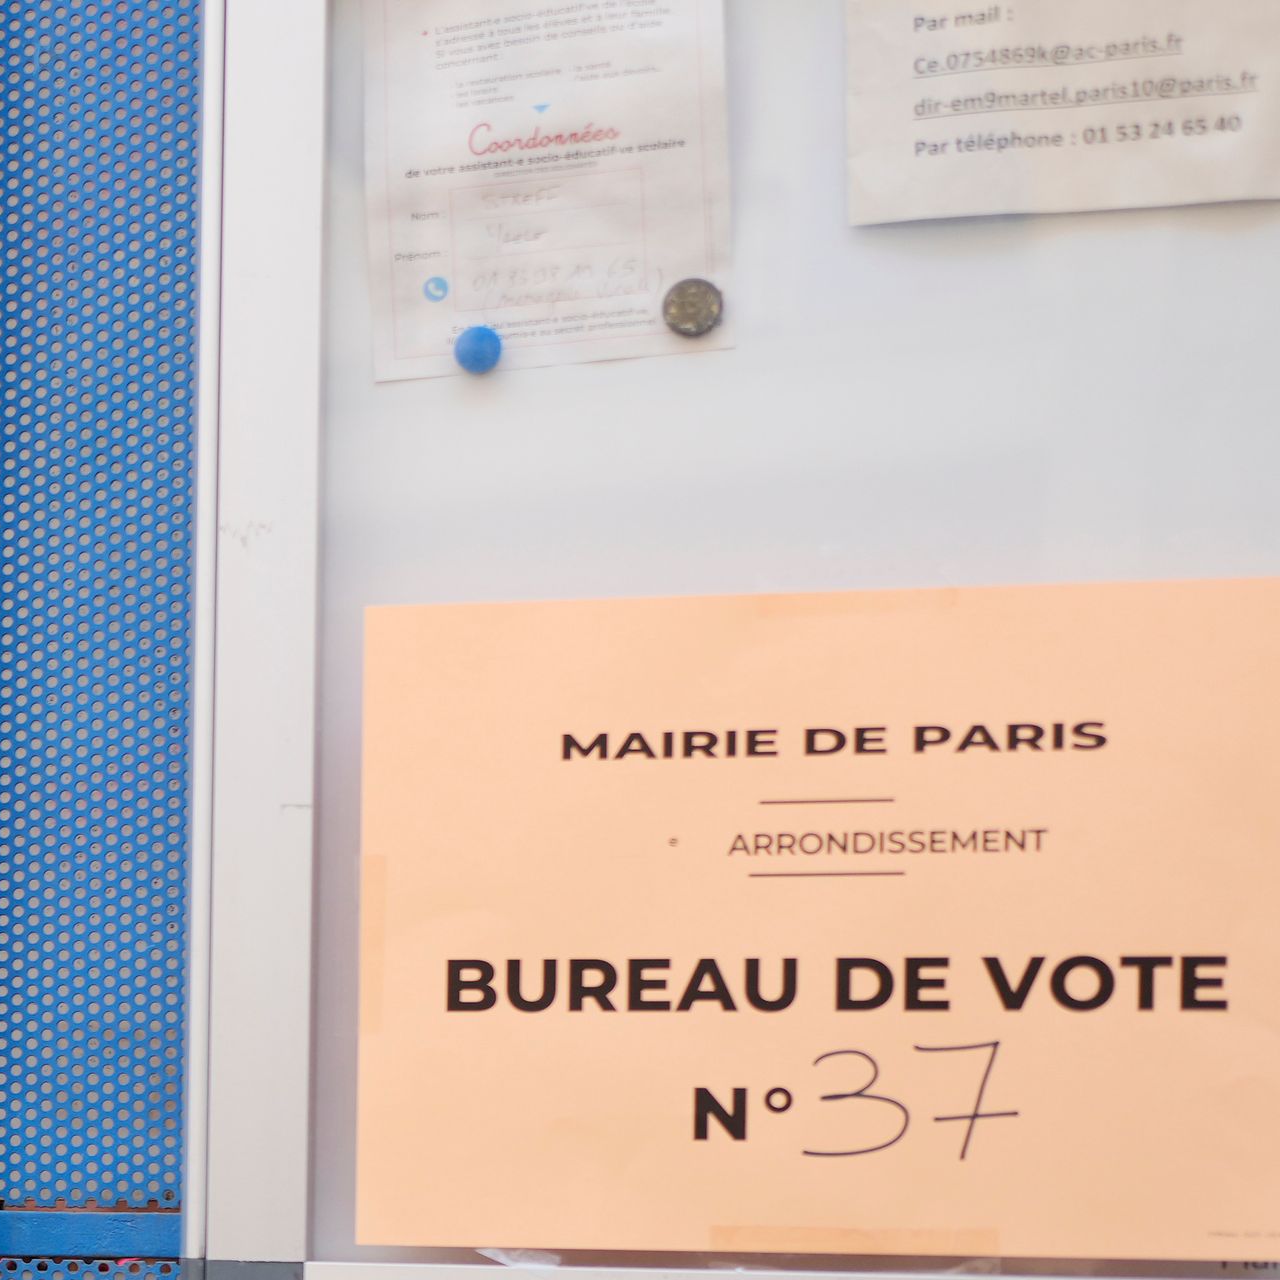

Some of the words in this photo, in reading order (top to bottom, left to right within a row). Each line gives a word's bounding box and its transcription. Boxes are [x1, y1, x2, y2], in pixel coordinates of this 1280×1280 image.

[913, 15, 948, 32] Par
[954, 6, 1000, 28] mail
[467, 121, 620, 156] Coordonnées
[914, 140, 948, 157] Par
[956, 131, 1064, 155] téléphone
[1082, 127, 1108, 146] 01
[1115, 124, 1142, 143] 53
[1148, 121, 1175, 140] 24
[1181, 118, 1207, 136] 65
[1214, 115, 1242, 133] 40
[405, 168, 421, 179] de
[423, 164, 455, 177] votre
[637, 138, 686, 153] scolaire
[410, 209, 440, 223] Nom
[561, 729, 779, 760] MAIRIE
[803, 726, 888, 756] DE
[913, 721, 1109, 754] PARIS
[728, 829, 1049, 857] ARRONDISSEMENT
[446, 957, 798, 1013] BUREAU
[835, 956, 951, 1011] DE
[982, 955, 1229, 1012] VOTE
[692, 1086, 794, 1141] N°
[802, 1040, 1020, 1160] 37
